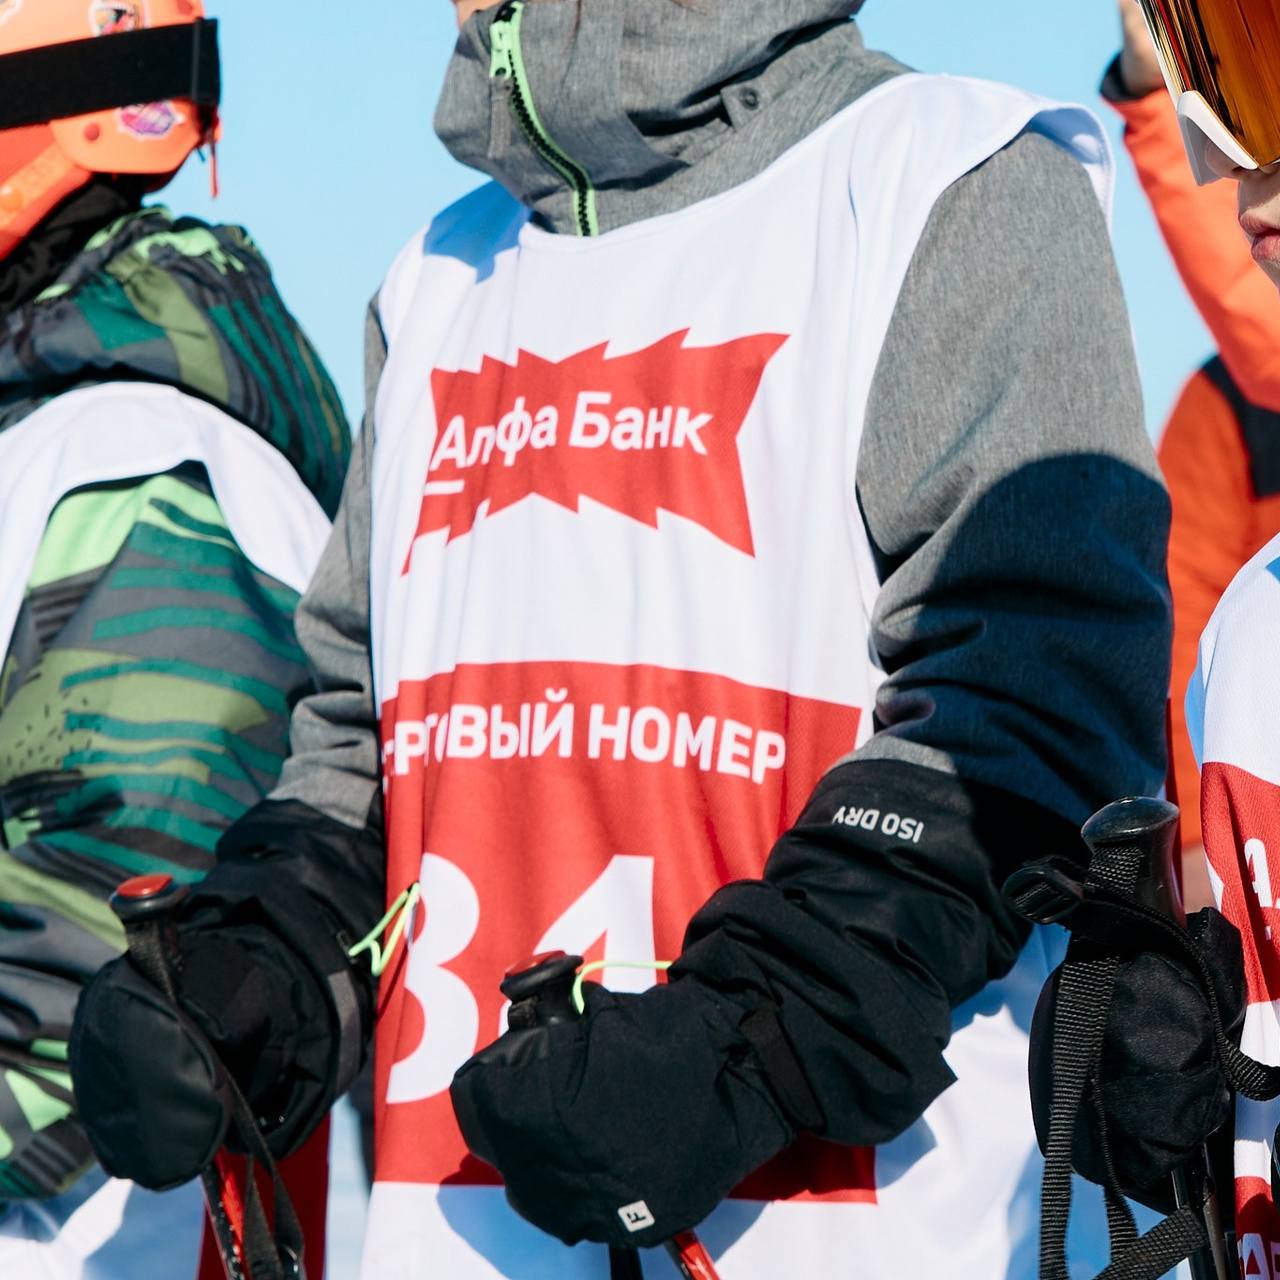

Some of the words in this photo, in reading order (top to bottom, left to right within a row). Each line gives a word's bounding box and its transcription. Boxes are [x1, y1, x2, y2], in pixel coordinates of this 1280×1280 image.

[429, 396, 559, 472] Алфа
[569, 391, 714, 456] Банк
[588, 703, 787, 786] НОМЕР
[831, 805, 880, 831] DRY
[881, 812, 925, 844] ISO
